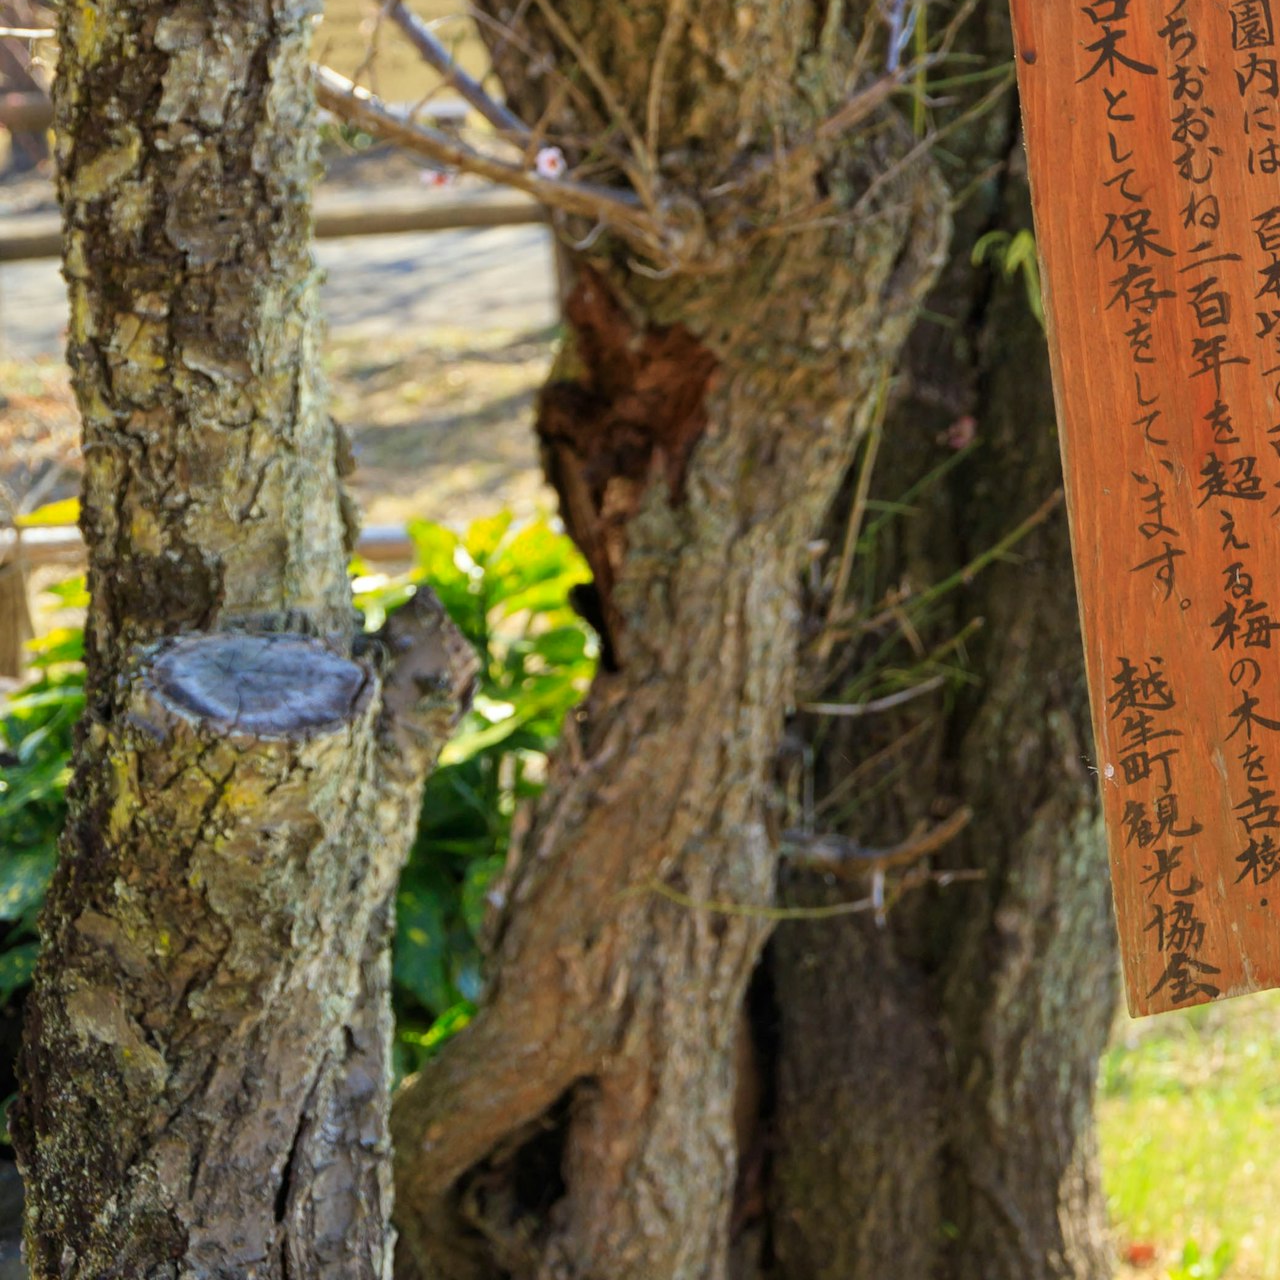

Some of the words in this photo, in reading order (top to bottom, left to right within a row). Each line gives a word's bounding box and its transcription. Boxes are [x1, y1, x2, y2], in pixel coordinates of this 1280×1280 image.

[1109, 656, 1221, 1004] 越生町観光協会
